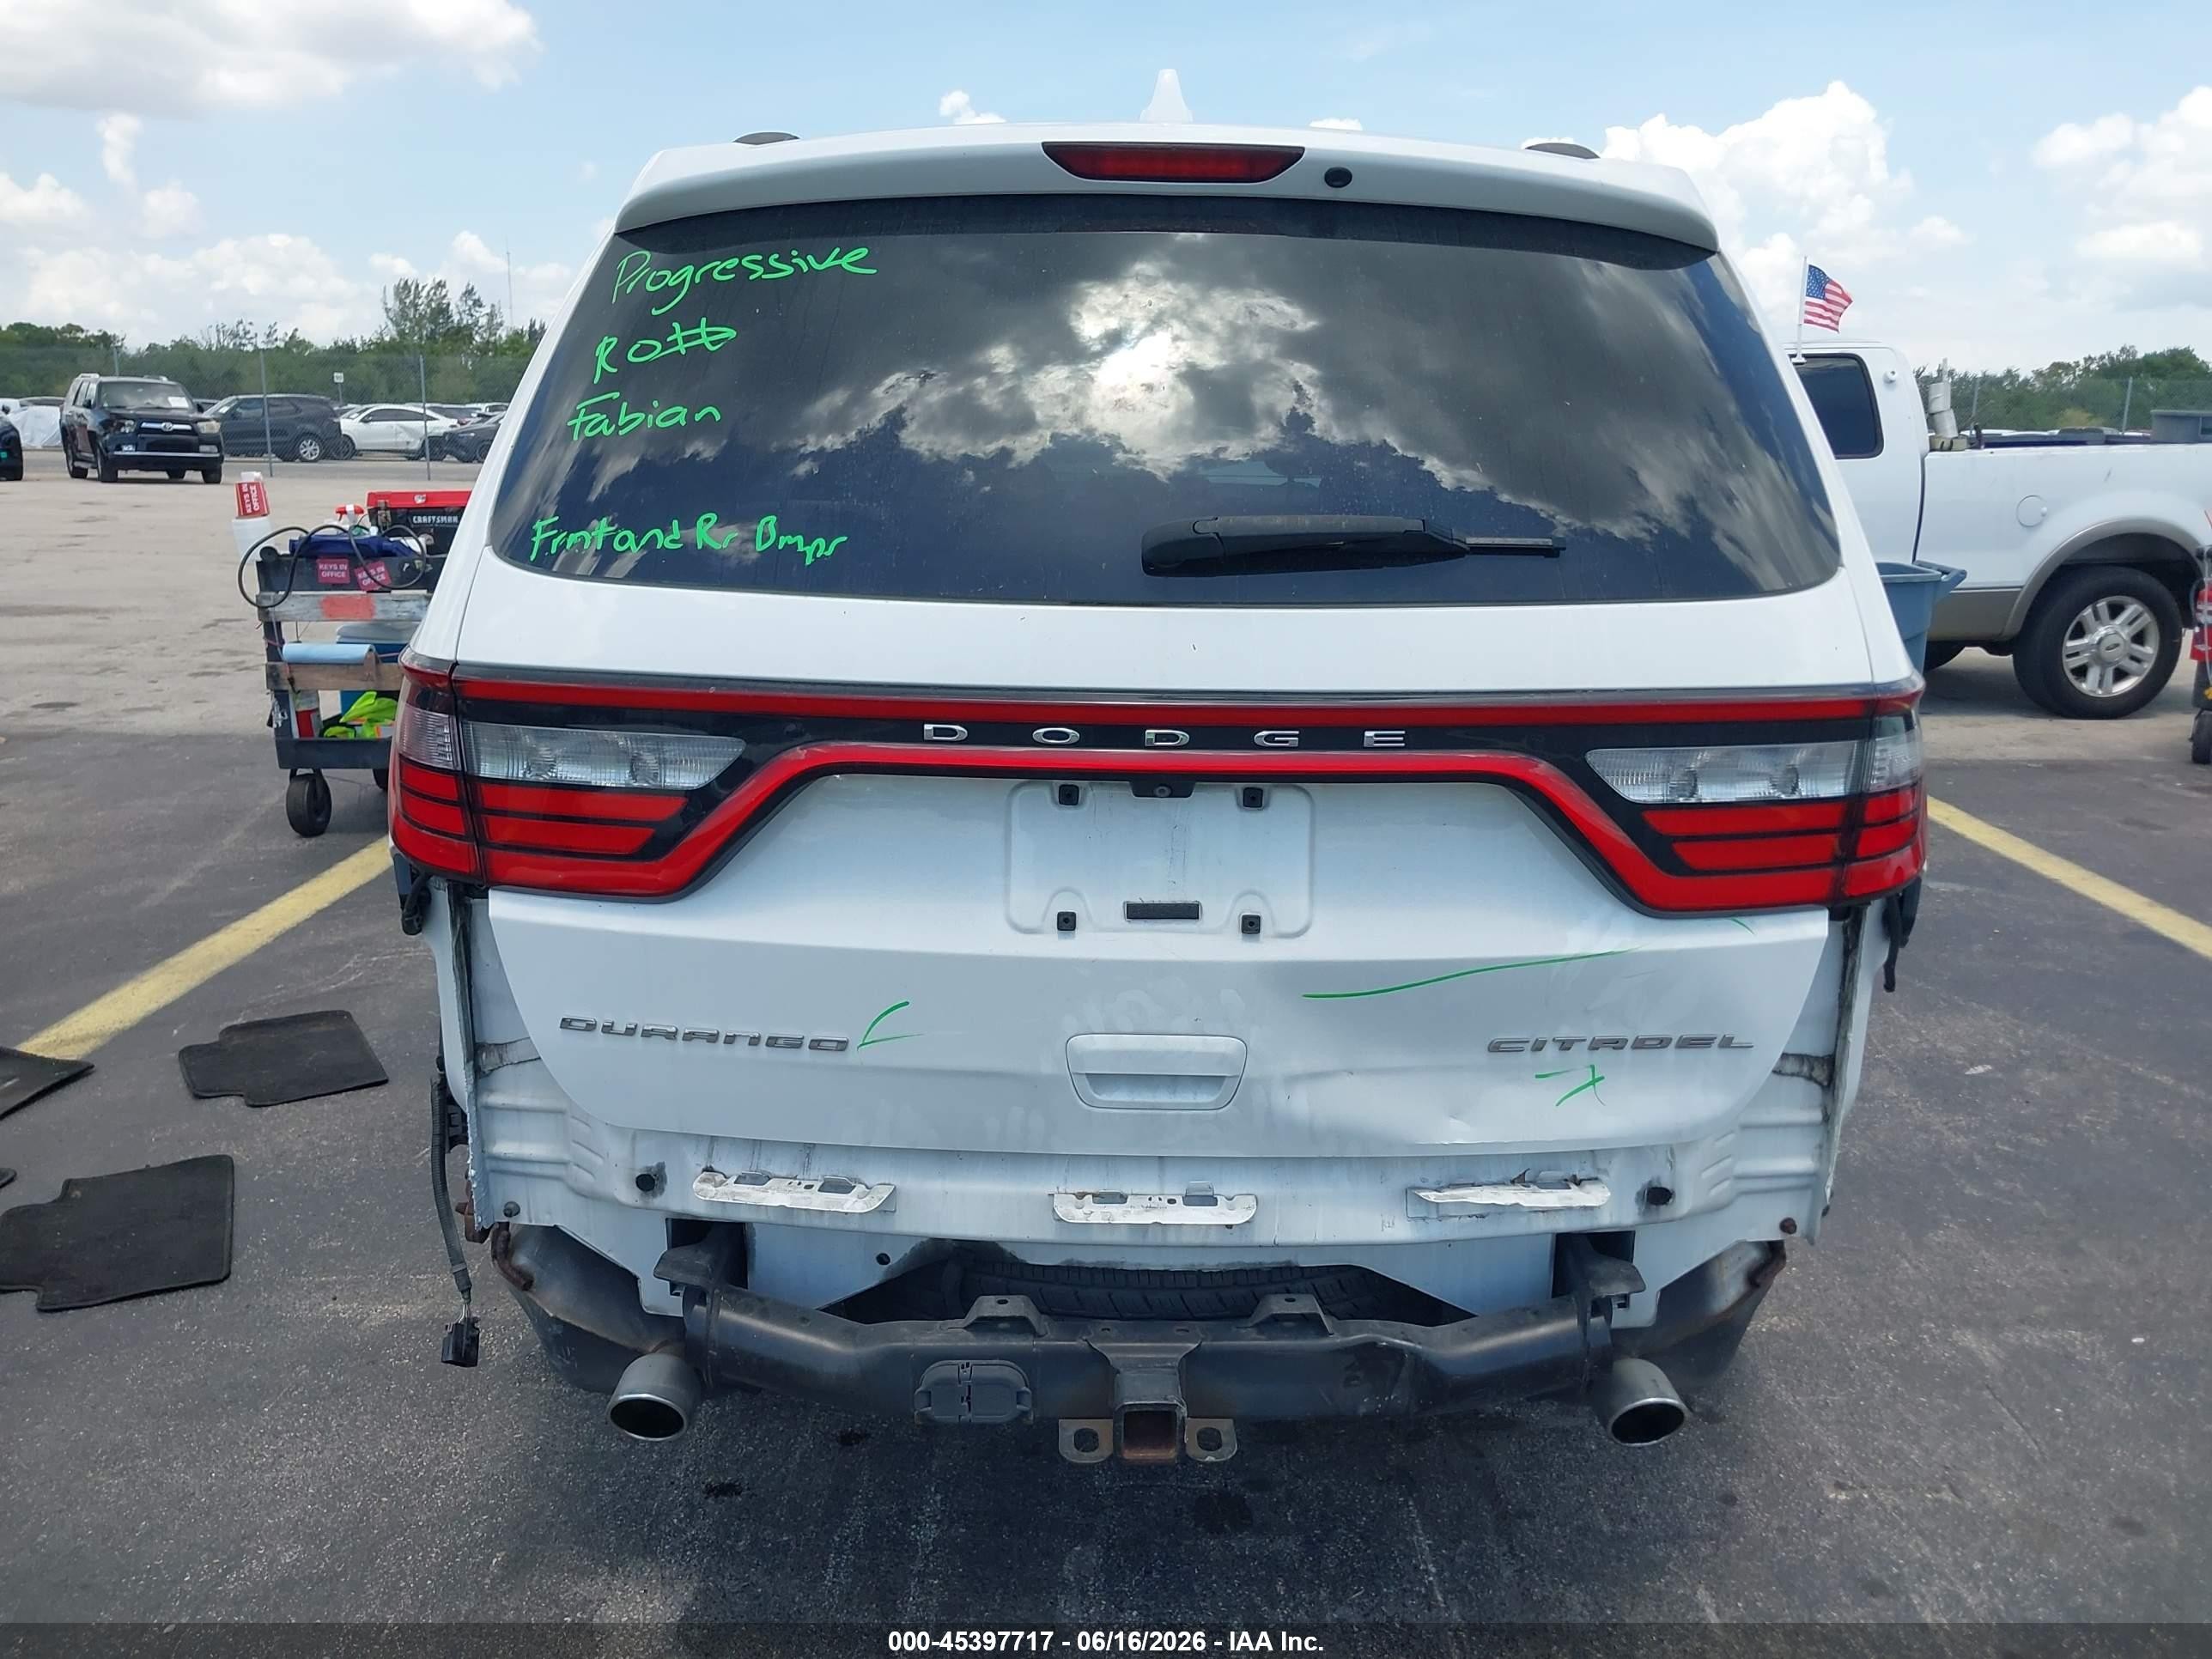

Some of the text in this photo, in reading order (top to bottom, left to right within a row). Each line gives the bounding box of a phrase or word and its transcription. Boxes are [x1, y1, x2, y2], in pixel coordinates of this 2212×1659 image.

[611, 246, 879, 316] Progressive
[567, 392, 721, 441] Fabian
[243, 493, 253, 514] KEYS
[249, 484, 260, 511] OFFICE
[412, 515, 459, 524] CRAFTSMAN
[357, 568, 376, 579] KES
[923, 723, 1407, 748] DODGE
[559, 1015, 850, 1052] DURANGO
[1486, 1034, 1754, 1054] CITADEL
